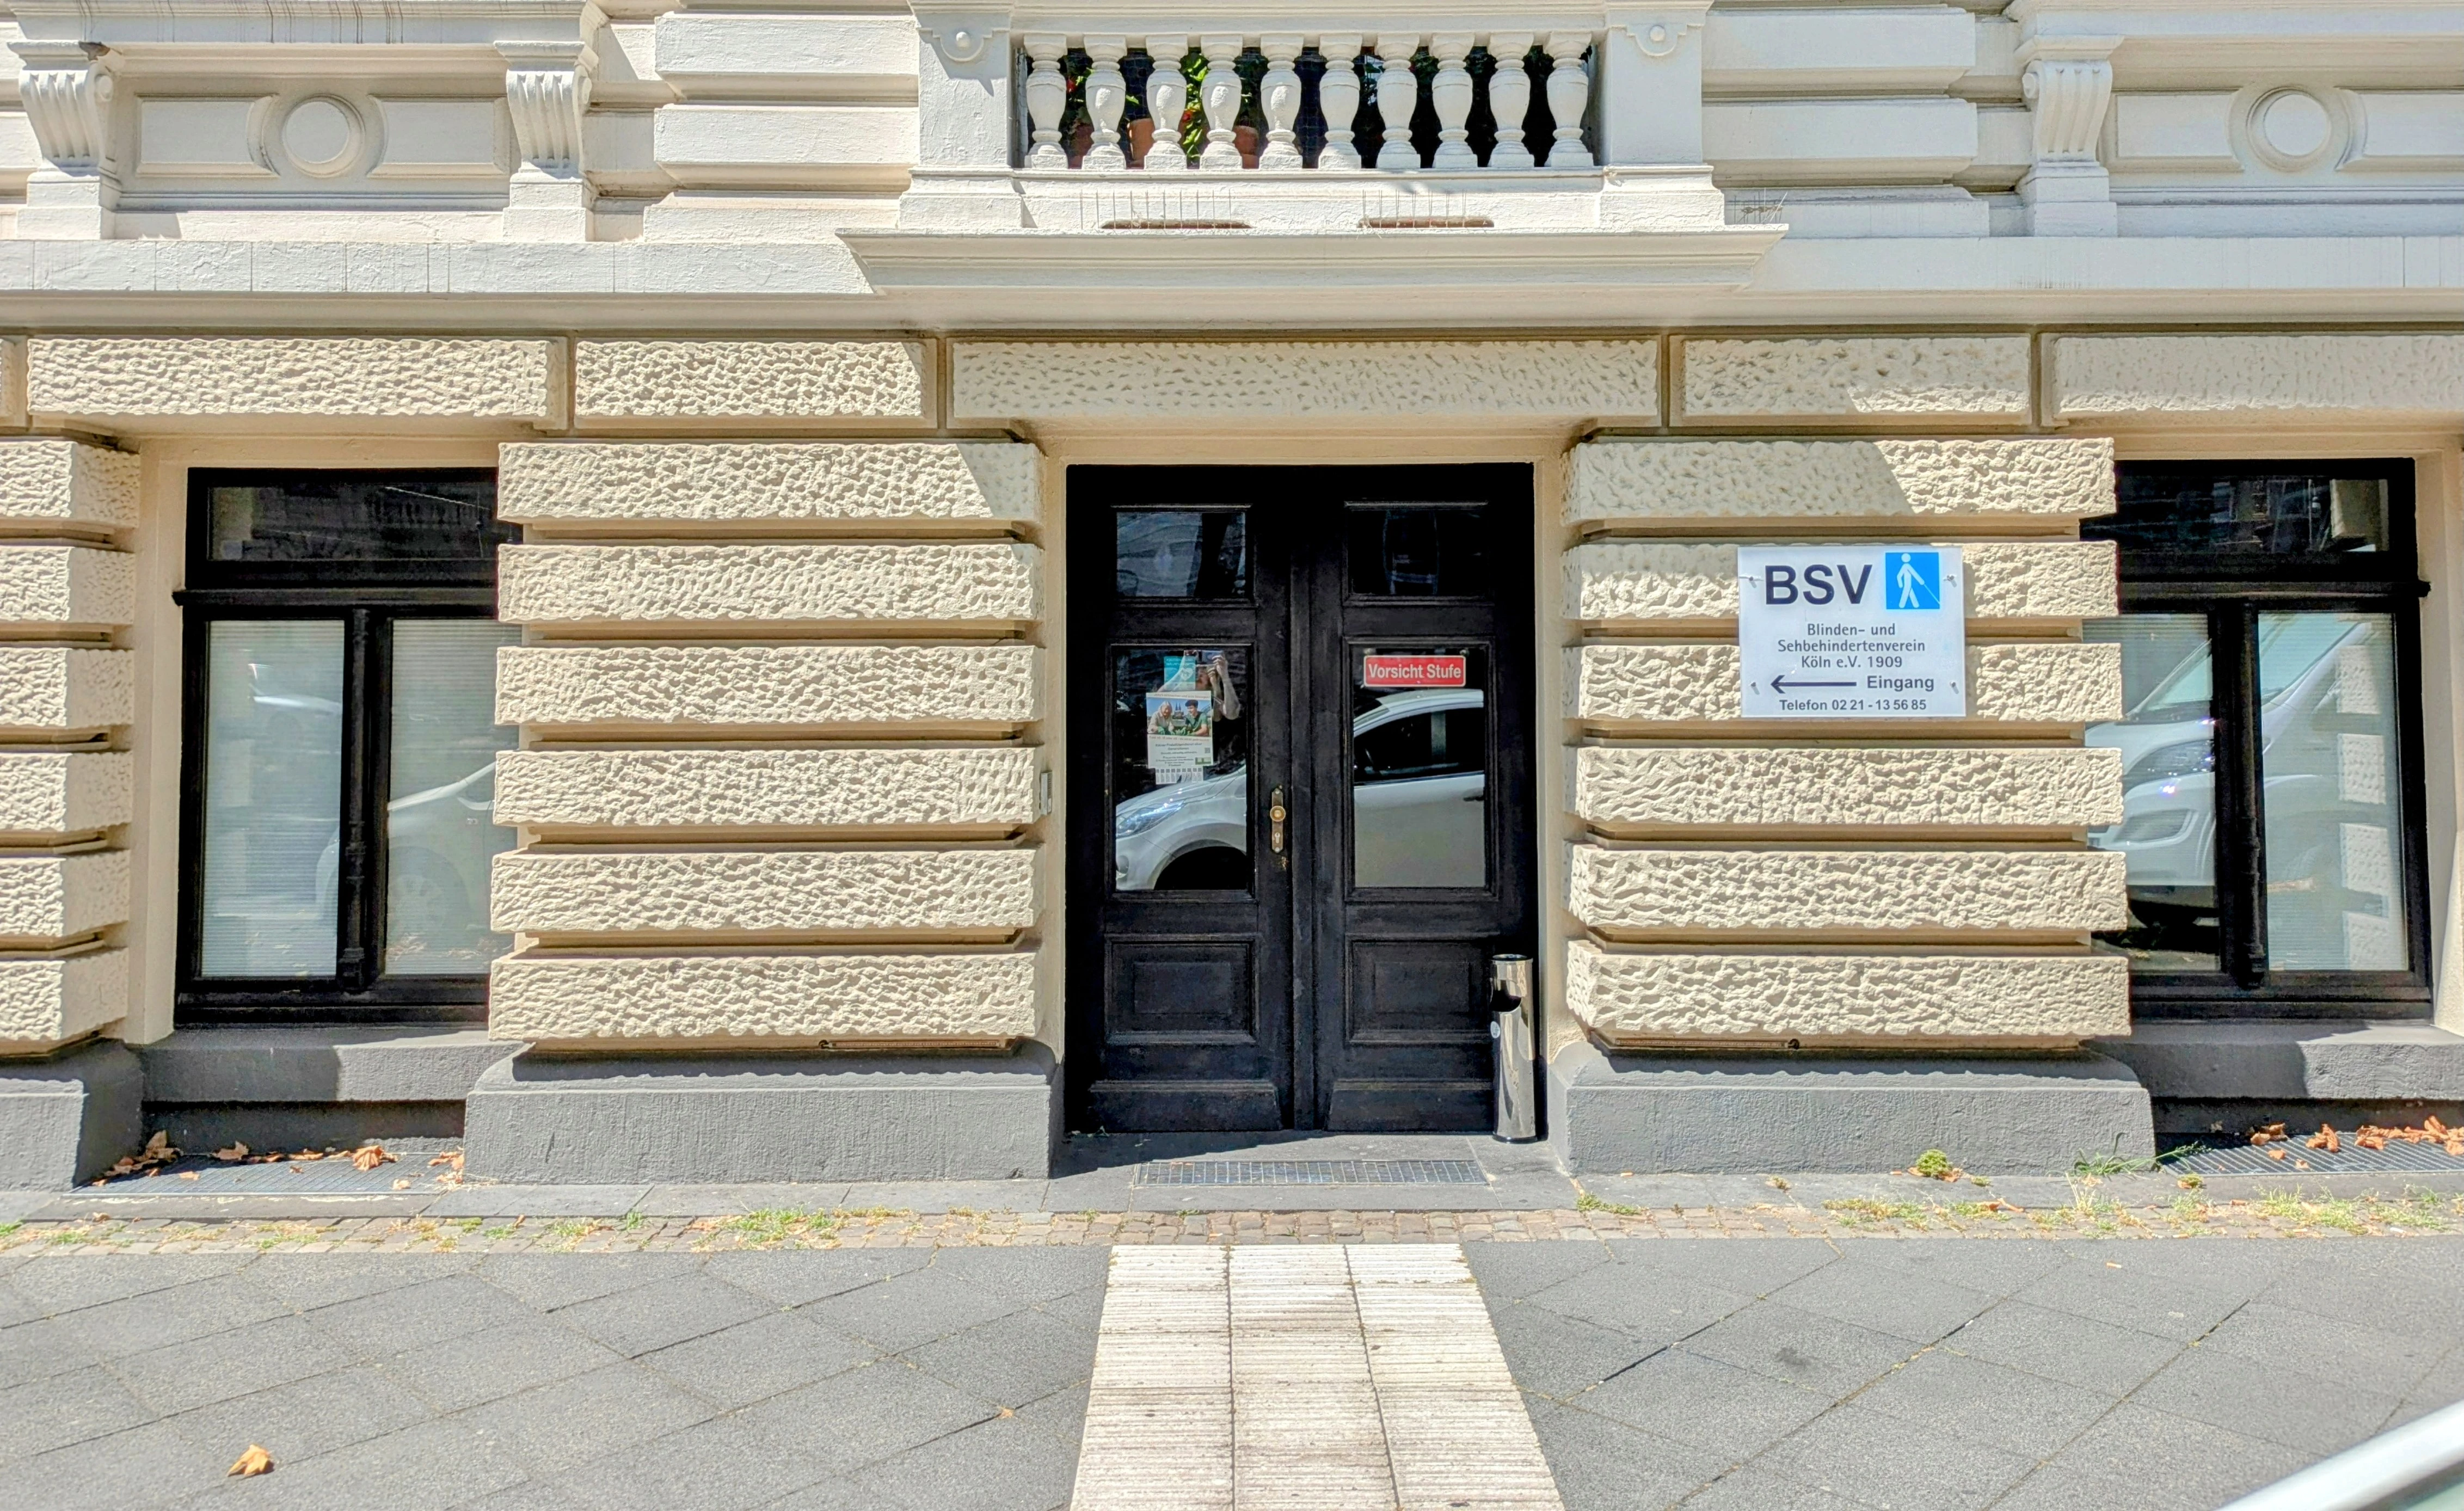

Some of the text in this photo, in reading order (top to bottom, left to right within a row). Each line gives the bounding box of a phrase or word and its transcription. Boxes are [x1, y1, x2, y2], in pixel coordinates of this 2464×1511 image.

[1765, 564, 1872, 605] BSV
[1808, 623, 1895, 636] Blinden- und
[1778, 639, 1925, 652] Sehbehindertenverein
[1802, 655, 1902, 668] Köln e.V. 1909
[1368, 664, 1461, 678] Vorsicht Stufe
[1867, 675, 1934, 692] Eingang
[1779, 699, 1828, 710] Telefon
